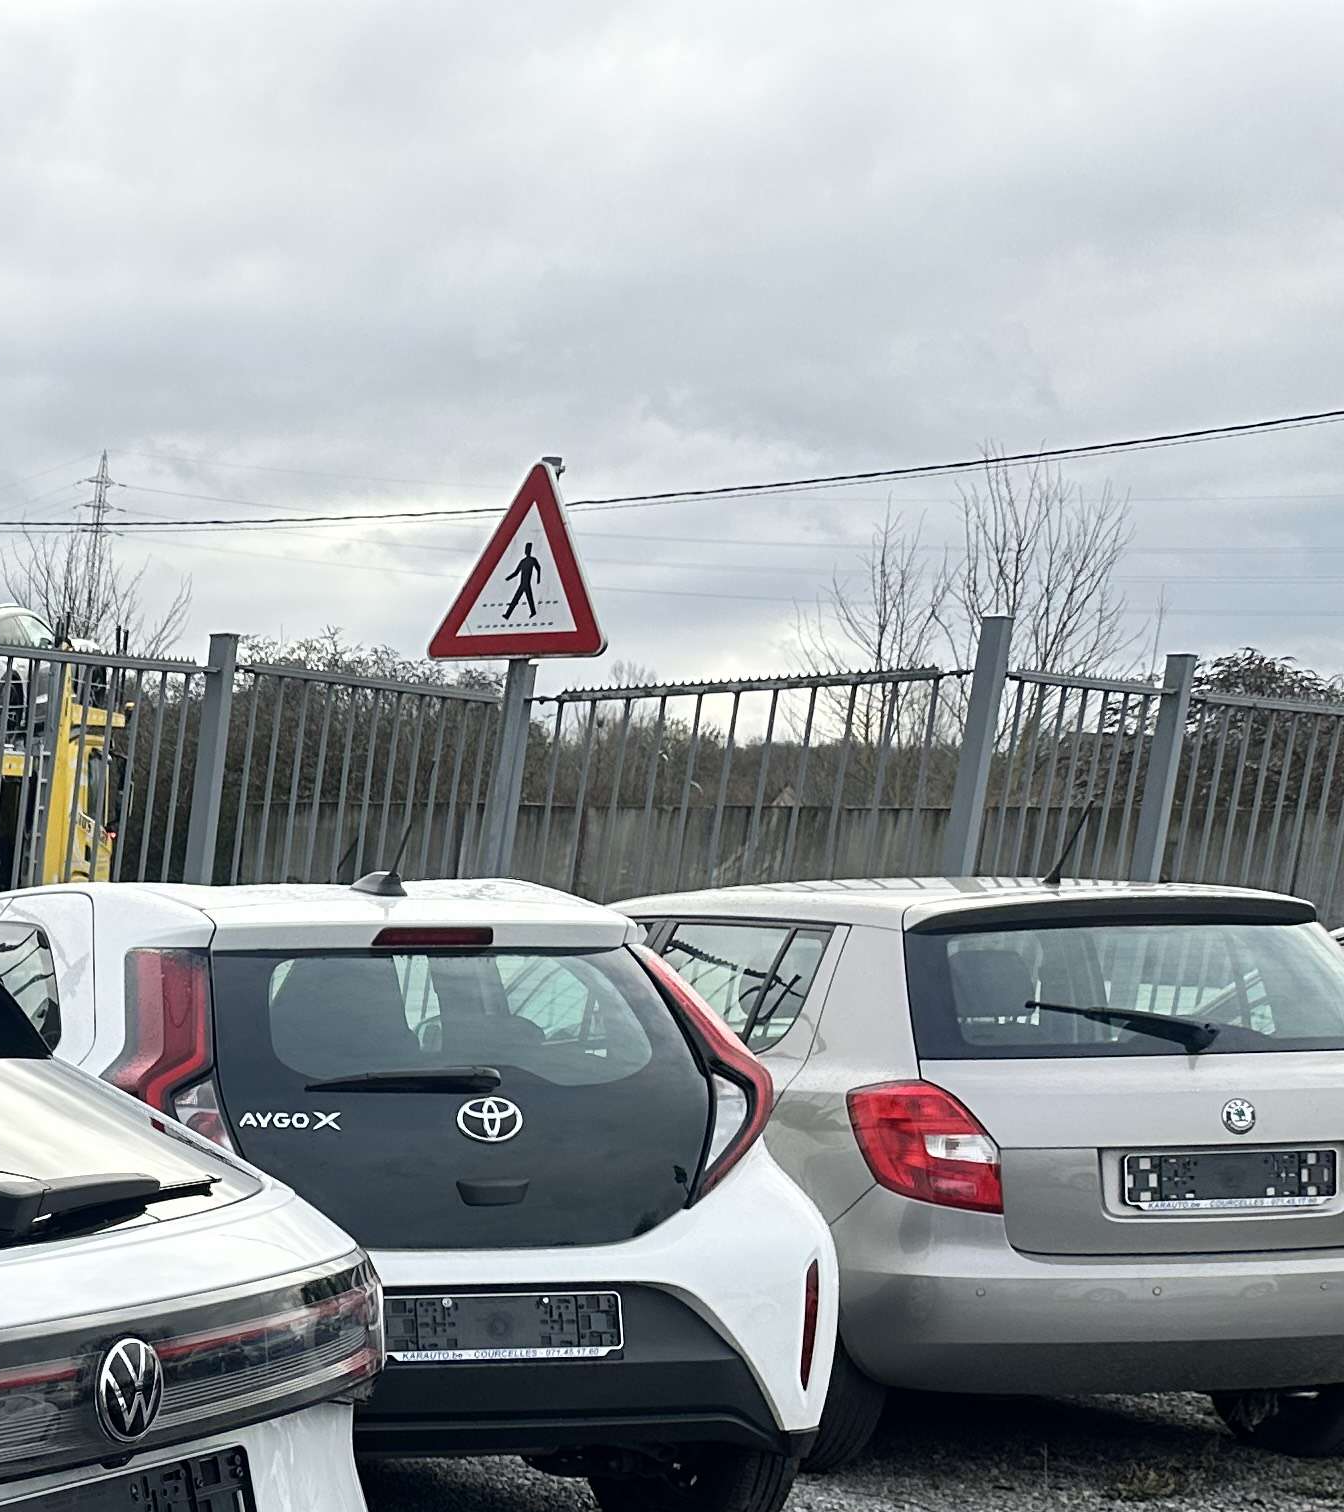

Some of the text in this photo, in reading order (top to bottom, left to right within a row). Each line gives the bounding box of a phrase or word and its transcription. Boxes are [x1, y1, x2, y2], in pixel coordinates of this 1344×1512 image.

[239, 1111, 342, 1131] AYGO X
[474, 1349, 538, 1359] COURCELLES
